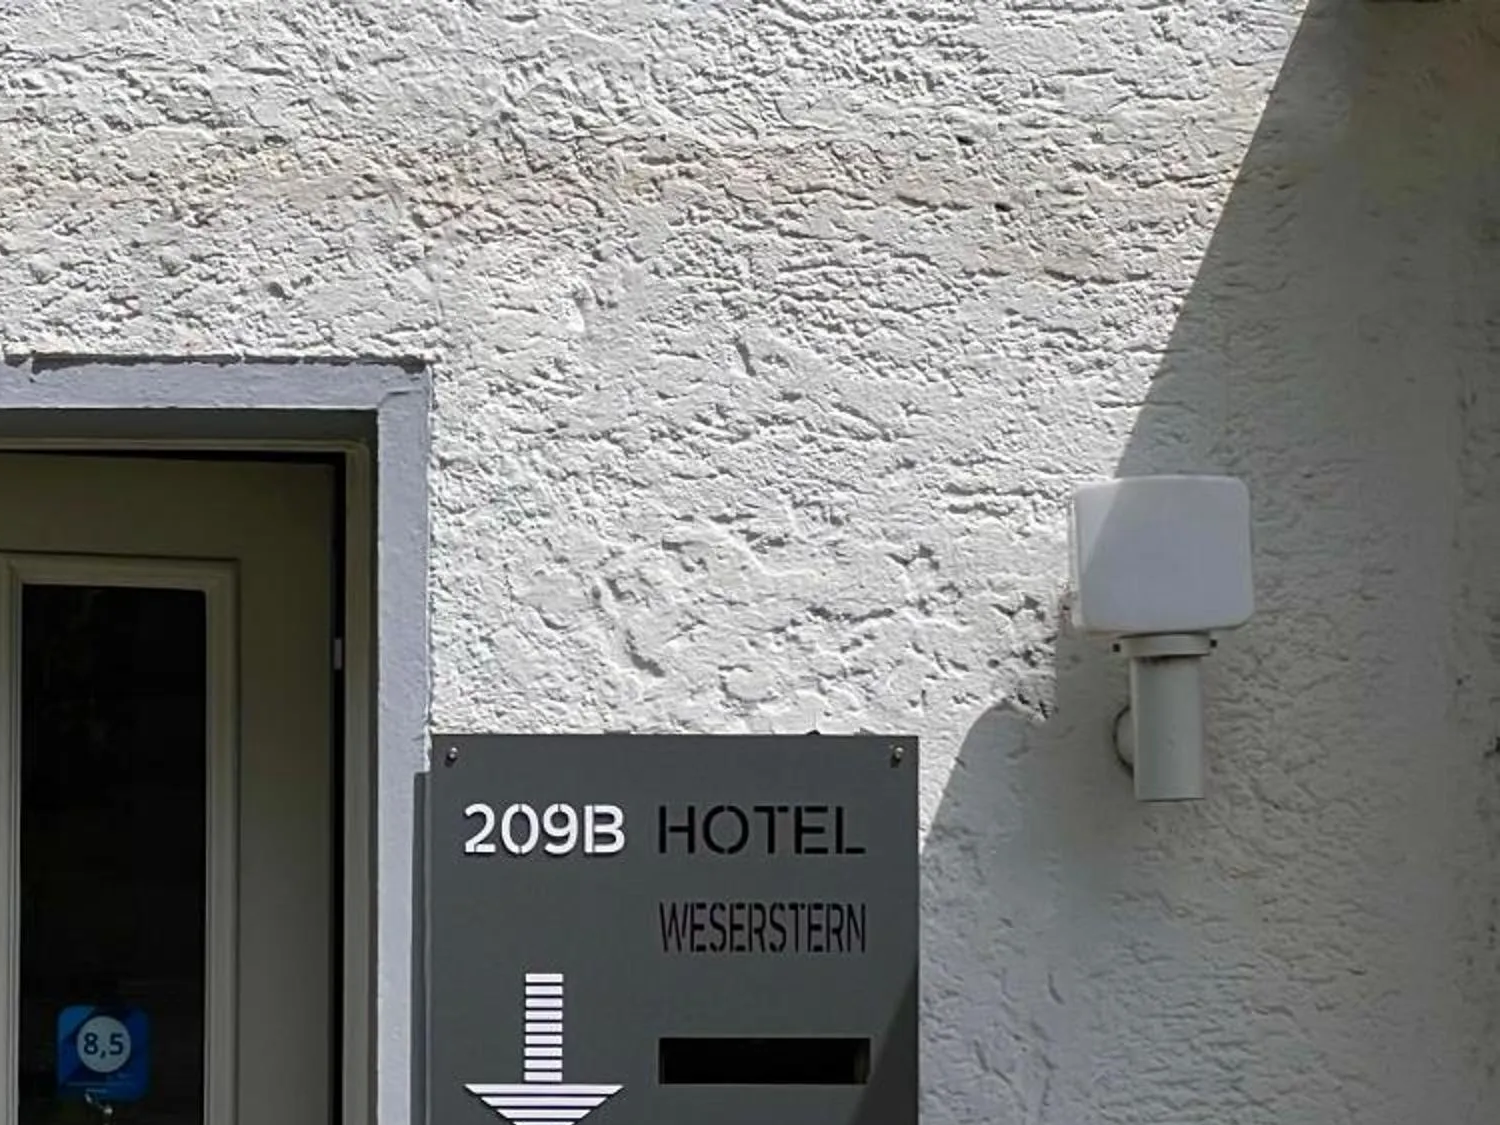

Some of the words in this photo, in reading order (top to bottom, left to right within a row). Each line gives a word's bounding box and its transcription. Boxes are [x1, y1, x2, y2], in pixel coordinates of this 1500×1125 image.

[463, 803, 626, 854] 209B
[658, 804, 867, 855] HOTEL
[658, 901, 867, 953] WESERSTERN
[83, 1032, 124, 1059] 8,5
